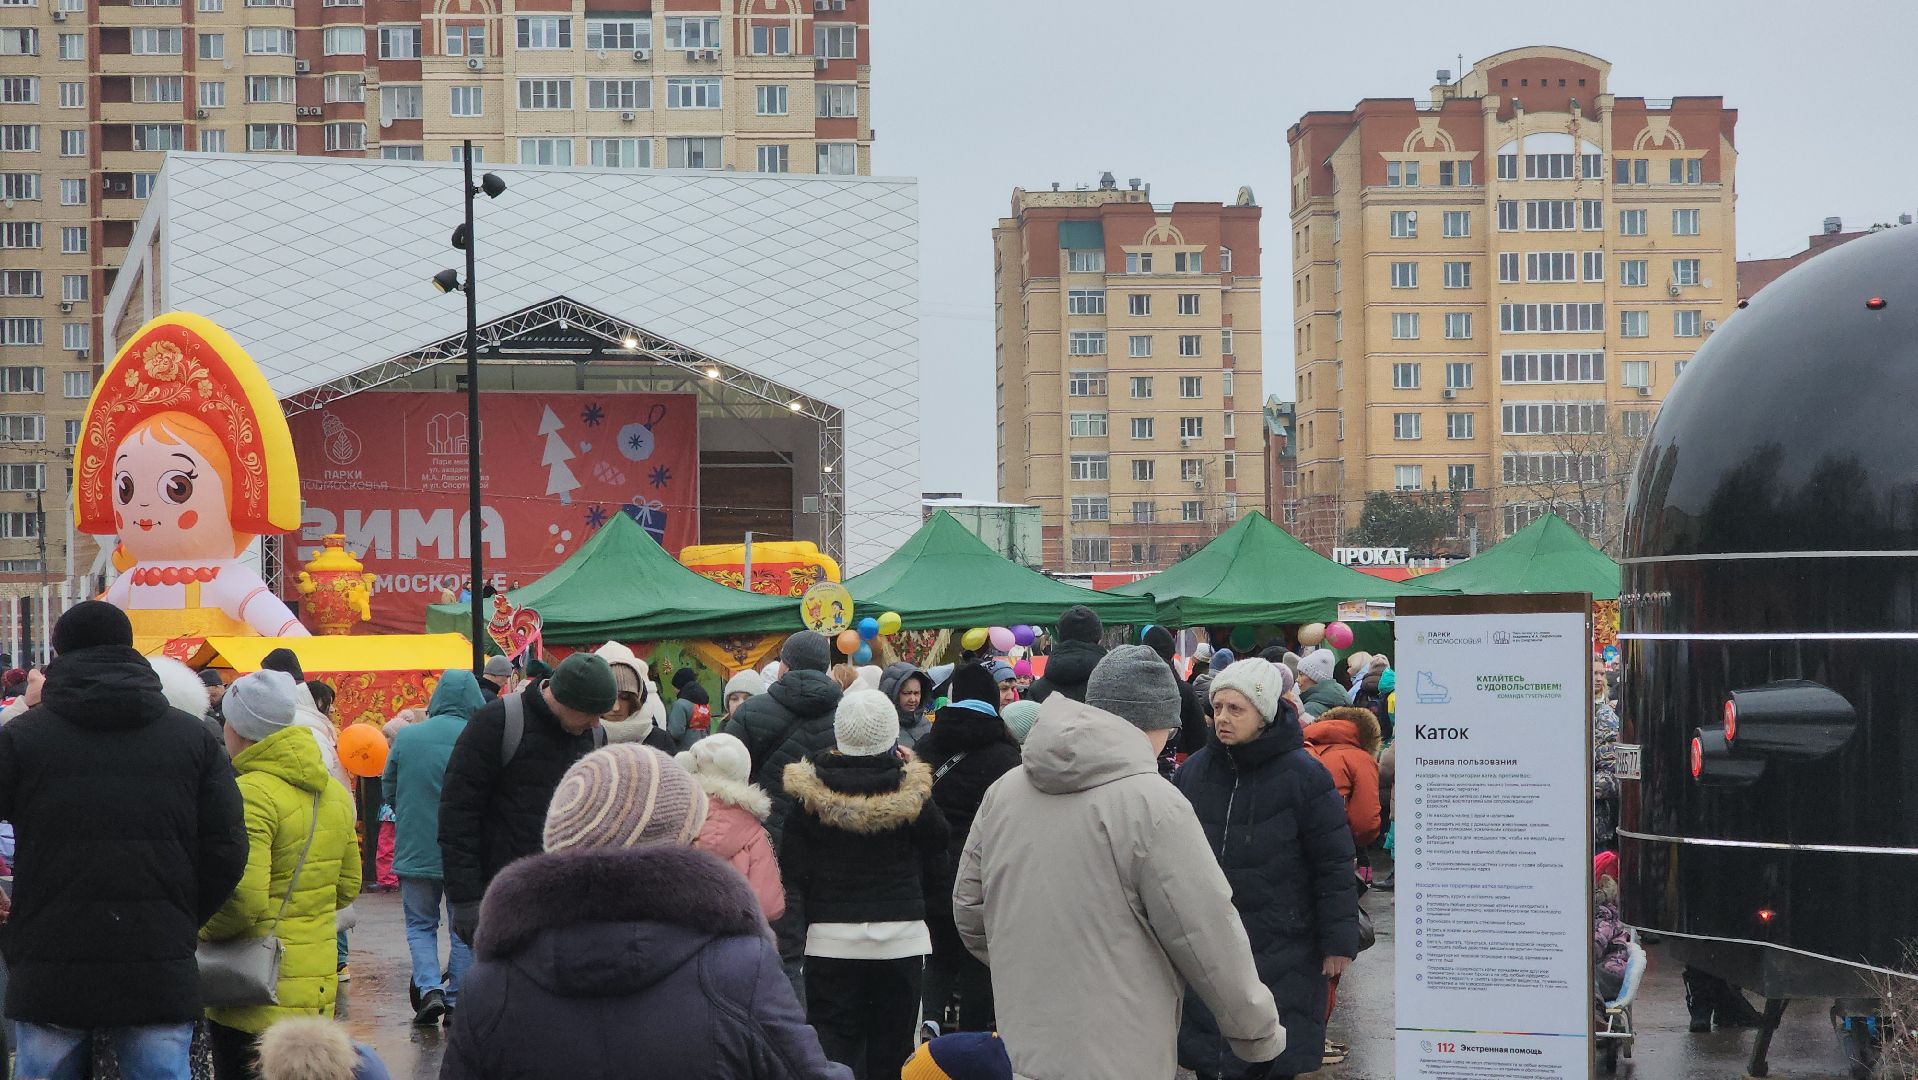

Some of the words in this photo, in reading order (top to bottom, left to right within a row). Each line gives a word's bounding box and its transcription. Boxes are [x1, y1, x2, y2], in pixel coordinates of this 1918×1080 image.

[324, 470, 362, 480] ПАРКИ
[297, 505, 507, 561] ЗИМА
[1332, 547, 1409, 565] ПРОКАТ
[1476, 674, 1525, 682] КАТАЙТЕСЬ
[1484, 683, 1562, 692] УДОВОЛЬСТВИЕМ!
[1415, 724, 1470, 740] Каток
[1415, 758, 1455, 767] Правила
[1457, 758, 1518, 766] пользования
[1437, 1042, 1456, 1053] 112
[1460, 1044, 1509, 1054] Экстренная
[1509, 1047, 1543, 1055] помощь
